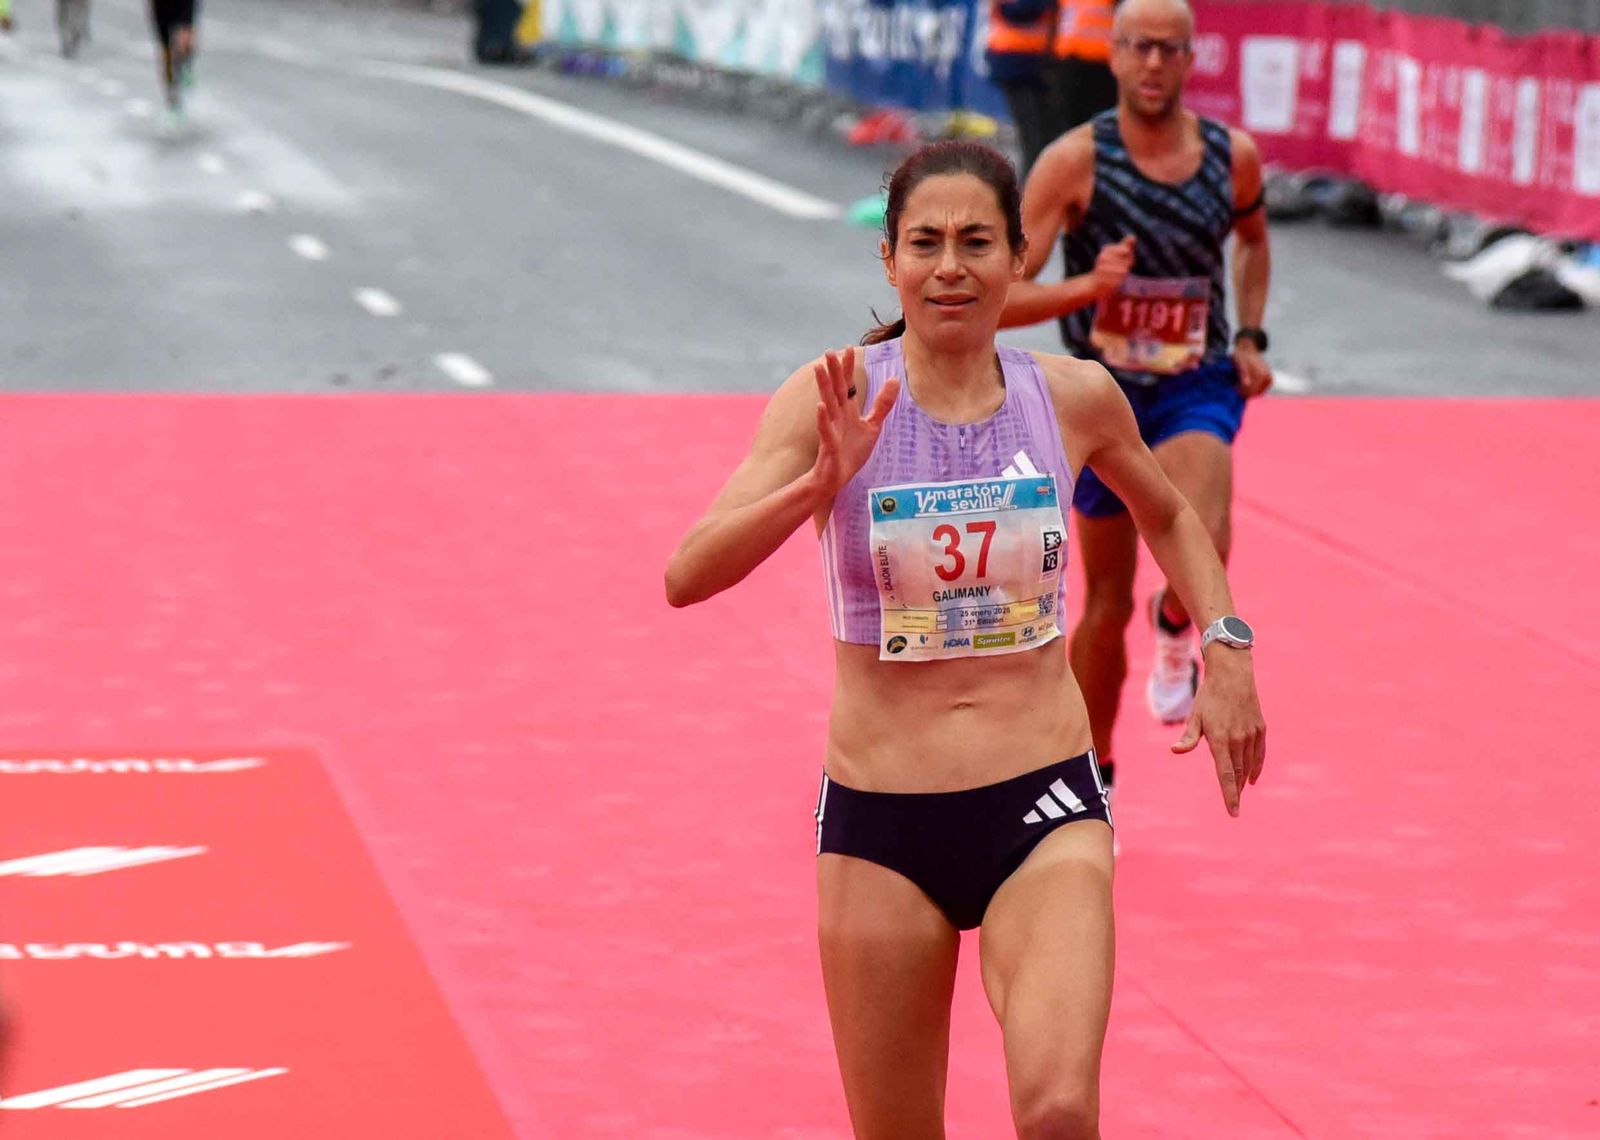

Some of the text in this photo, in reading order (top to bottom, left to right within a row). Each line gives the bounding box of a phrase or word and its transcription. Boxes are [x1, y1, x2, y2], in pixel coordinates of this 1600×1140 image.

[932, 483, 1001, 501] maratón
[950, 492, 1002, 511] sevilla
[932, 520, 997, 582] 37
[932, 586, 991, 602] GALIMANY
[960, 606, 1011, 617] 25 enero 2026
[943, 636, 970, 649] HOKA
